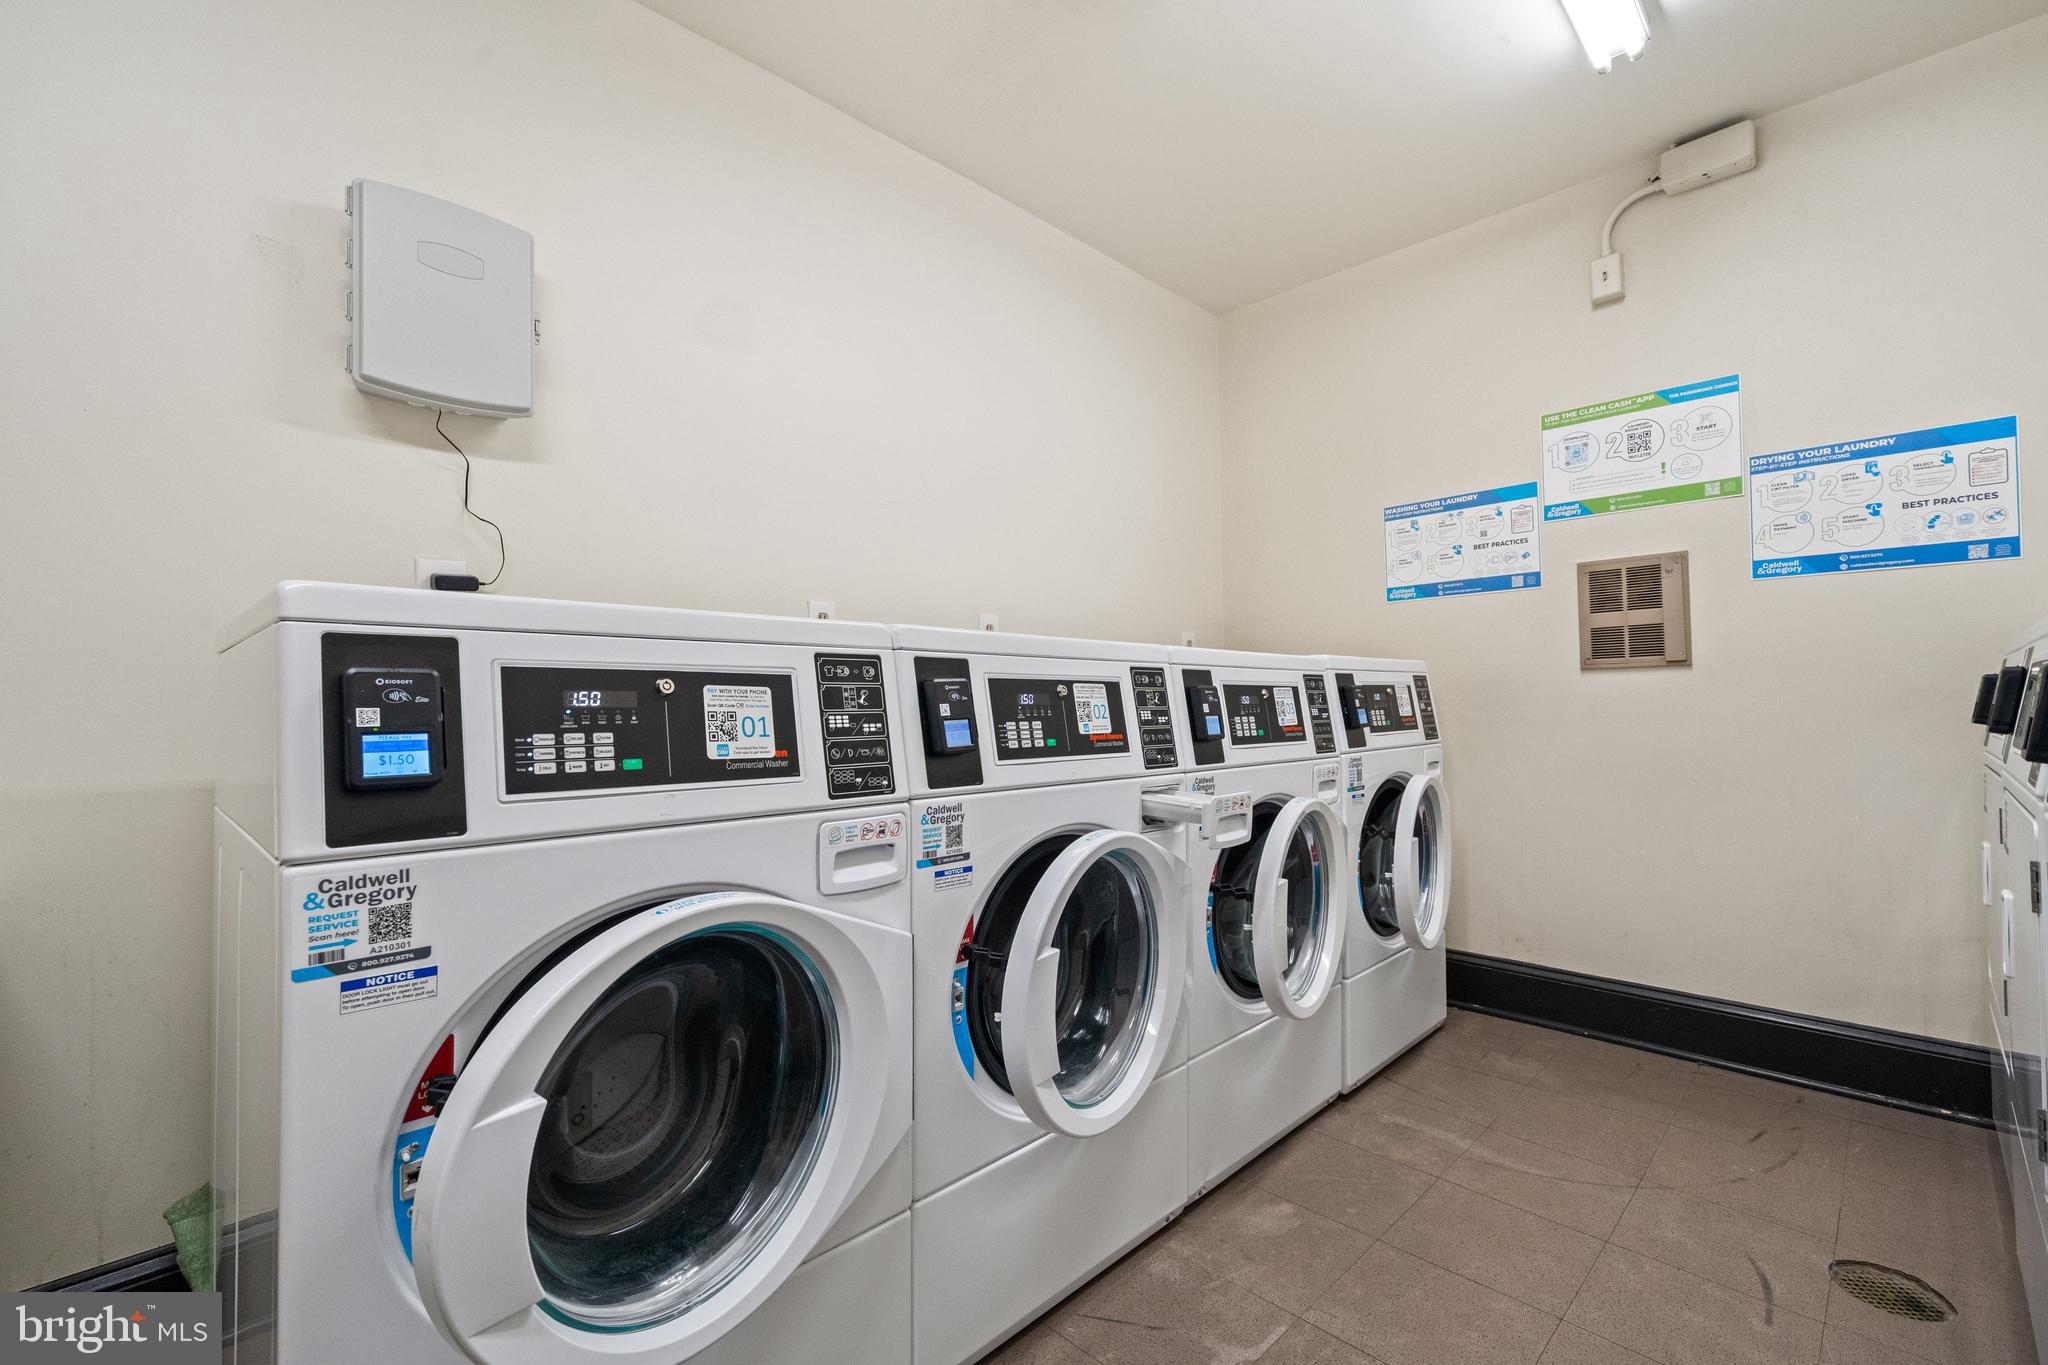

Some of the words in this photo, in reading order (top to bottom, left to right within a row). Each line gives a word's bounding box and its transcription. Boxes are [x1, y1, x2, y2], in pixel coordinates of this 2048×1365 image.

[1579, 405, 1606, 415] CLEAN
[1636, 395, 1655, 404] APP
[1670, 419, 1689, 447] 3
[1696, 423, 1717, 431] START
[1605, 432, 1623, 459] 2
[1751, 454, 1796, 466] DRYING
[1798, 448, 1831, 458] YOUR
[1834, 437, 1896, 453] LAUNDRY
[1751, 461, 1797, 472] STEP-BY-STEP
[1799, 453, 1851, 464] INSTRUCTIONS
[1889, 465, 1910, 492] 3
[1819, 475, 1839, 500] 2
[1384, 505, 1418, 515] WASHING
[1420, 501, 1440, 509] YOUR
[1442, 494, 1478, 505] LAUNDRY
[1902, 499, 1930, 509] BEST
[1933, 491, 1999, 505] PRACTICES
[1551, 503, 1579, 512] Caldwell
[1755, 525, 1773, 548] 4
[1821, 517, 1840, 542] 5
[1491, 538, 1529, 548] PRACTICES
[1762, 560, 1799, 568] Caldwell
[1093, 704, 1108, 719] 02
[1286, 703, 1294, 714] 03
[741, 716, 770, 738] 01
[379, 754, 414, 765] $1.50
[726, 760, 764, 769] Commercial
[765, 760, 788, 768] Washer
[1195, 776, 1214, 784] Caldwell
[926, 803, 962, 815] Caldwell
[318, 868, 410, 894] Caldwell
[308, 910, 359, 923] REQUEST
[308, 920, 359, 934] SERVICE
[308, 935, 332, 943] Scan
[335, 929, 360, 939] here!
[370, 941, 411, 955] A210301
[361, 953, 414, 967] 800.927.9274
[366, 971, 415, 987] NOTICE
[361, 992, 390, 1001] attempting
